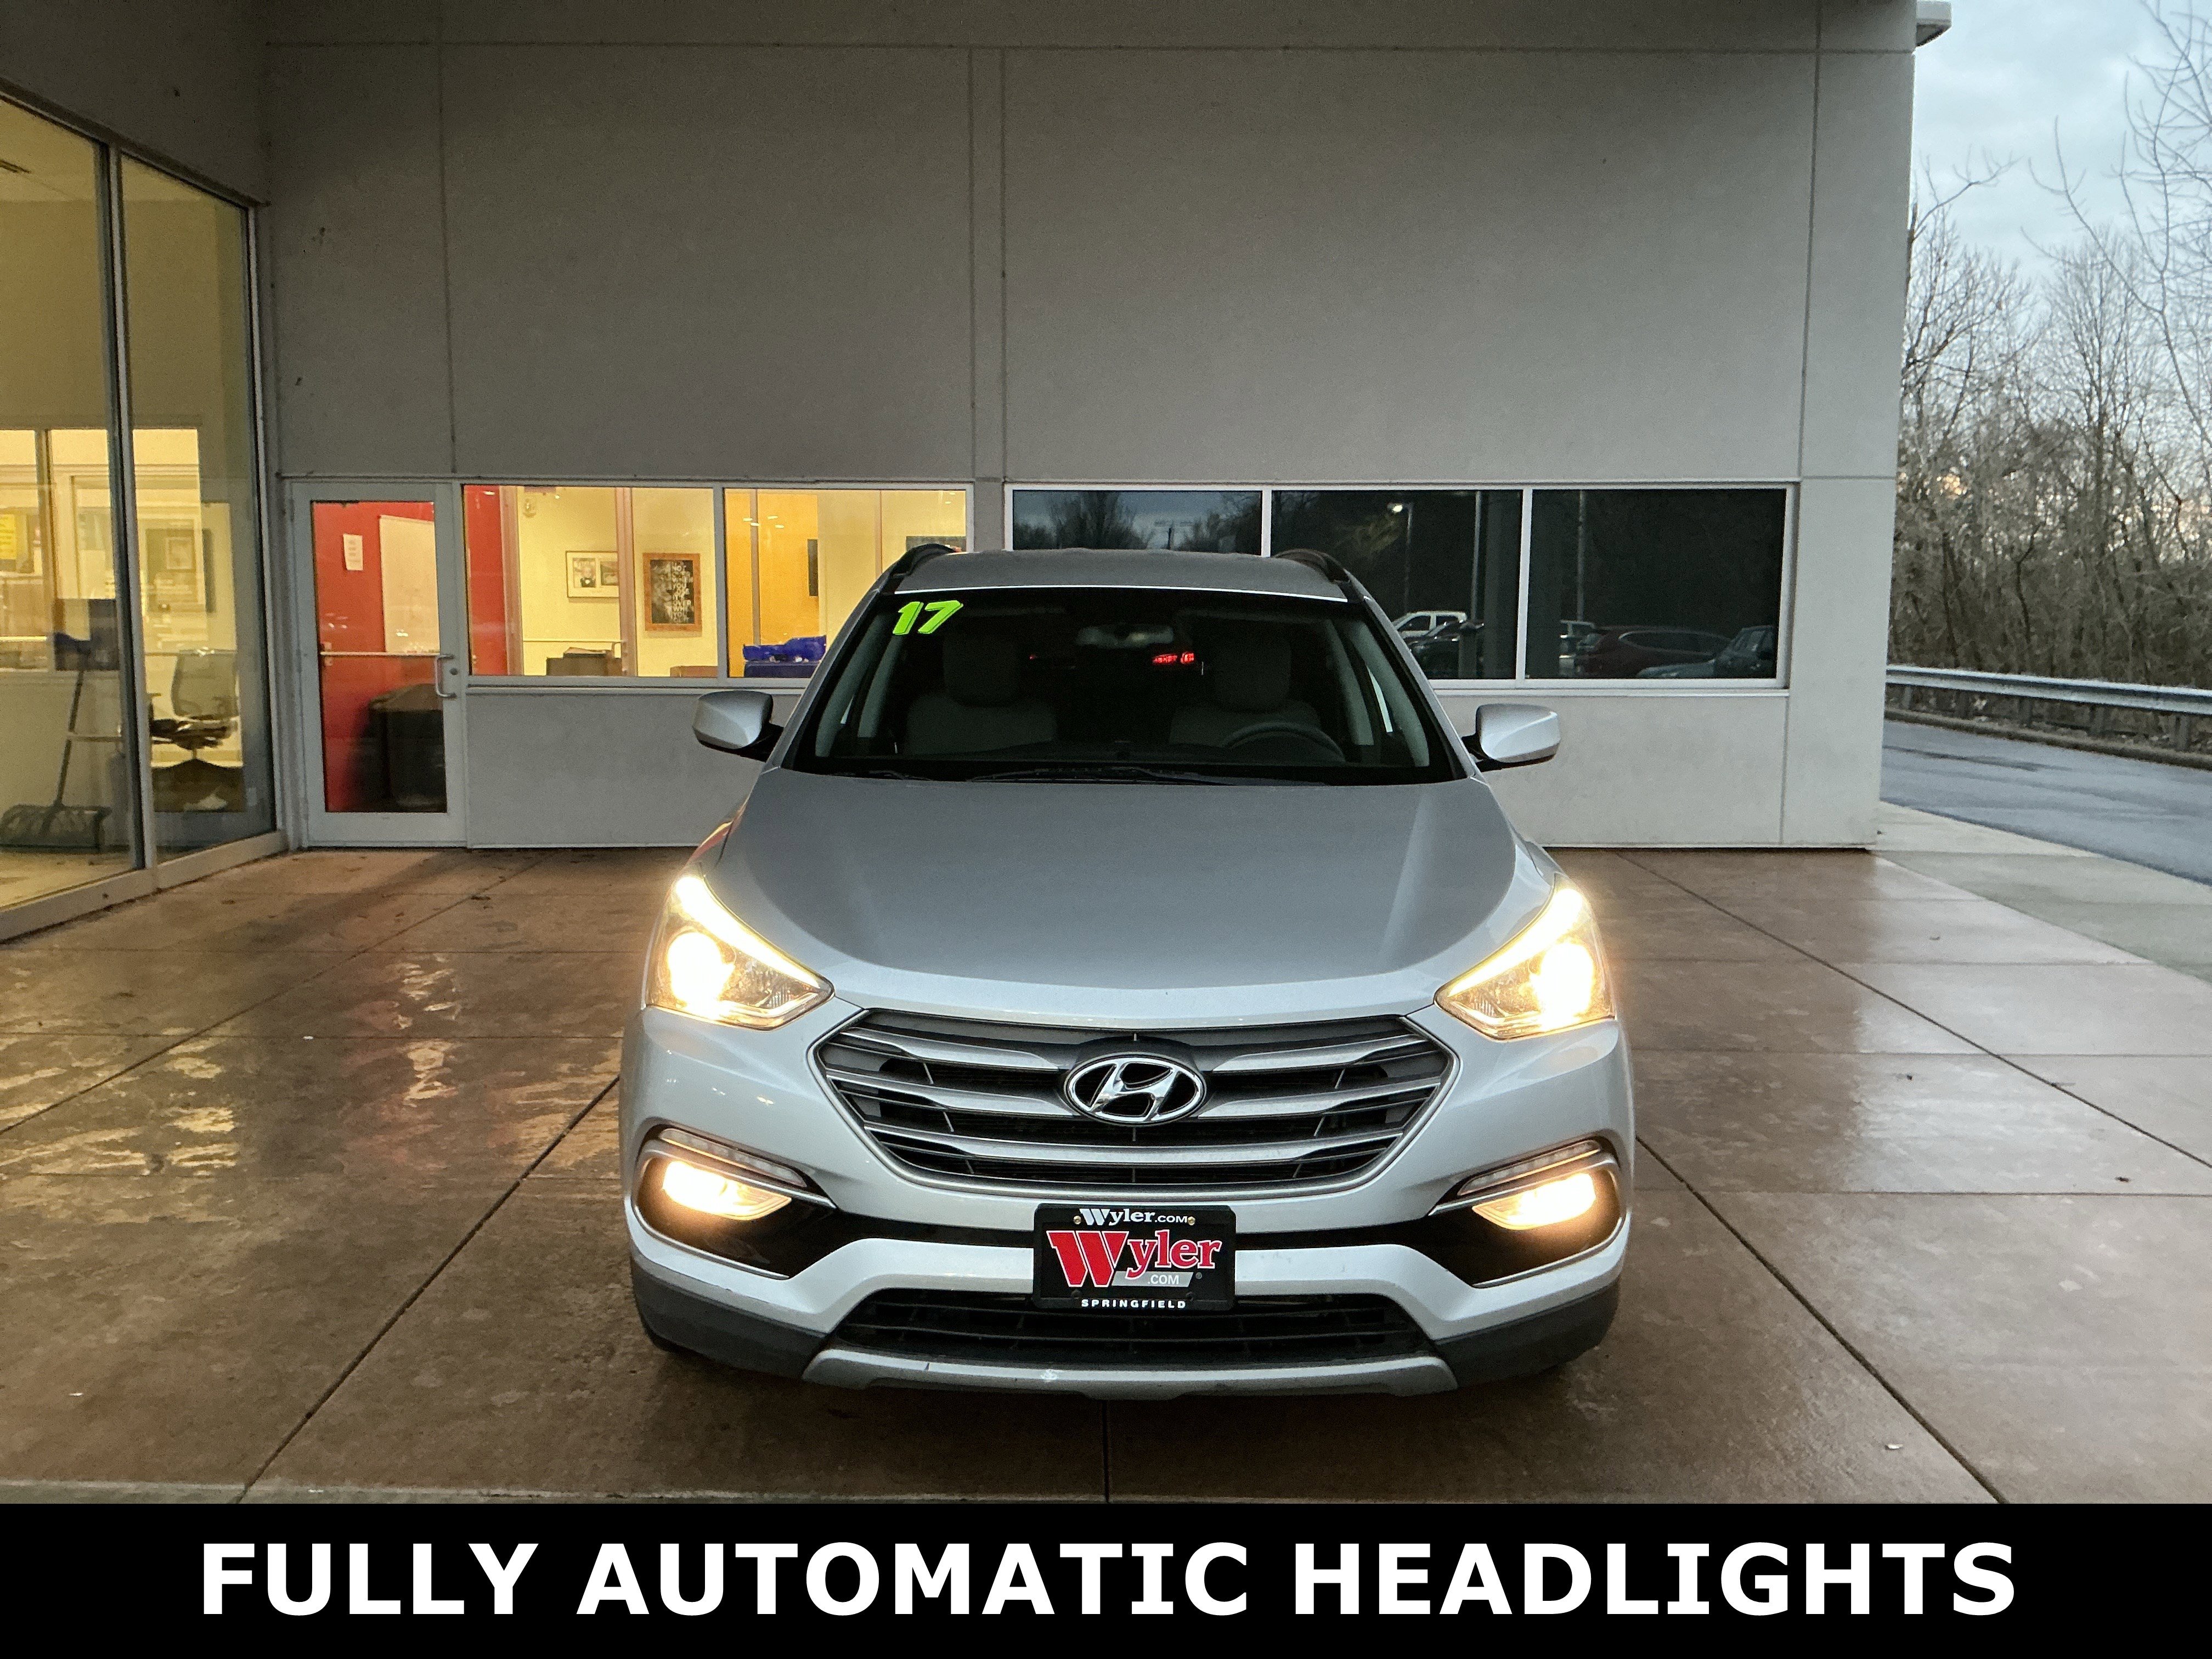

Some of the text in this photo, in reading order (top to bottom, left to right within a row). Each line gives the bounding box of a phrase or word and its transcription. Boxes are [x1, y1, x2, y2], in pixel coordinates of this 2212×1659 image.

[892, 600, 964, 635] 17
[1046, 1229, 1222, 1288] Wyler
[1081, 1299, 1186, 1308] SPRINGFIELD
